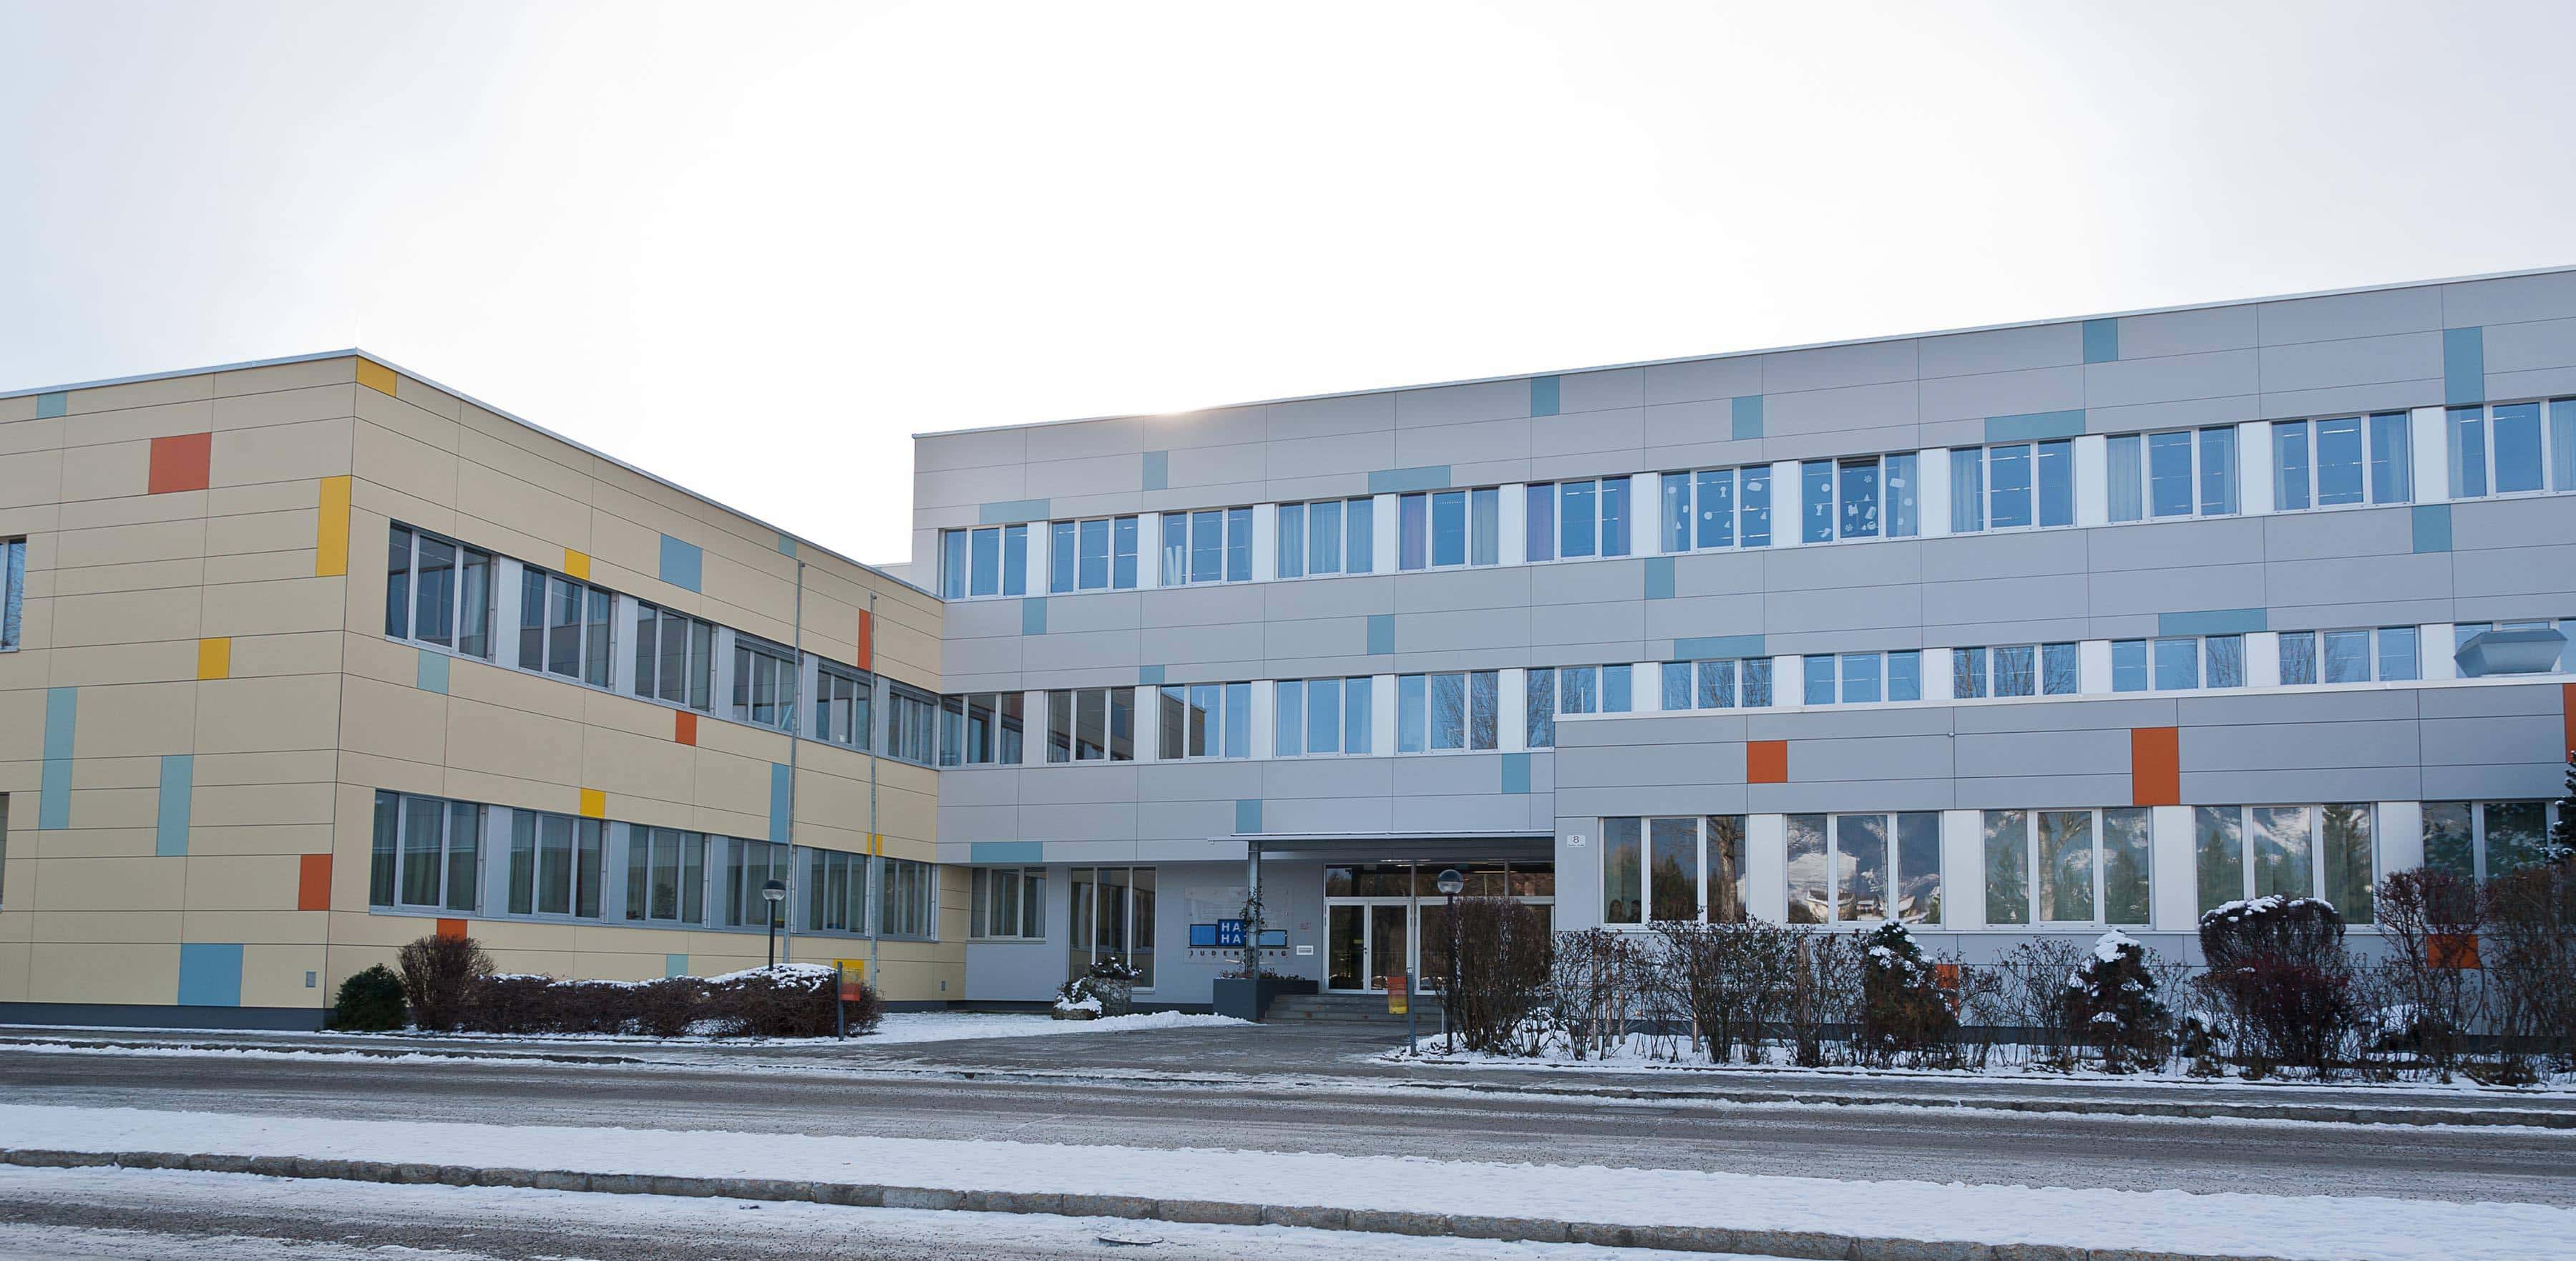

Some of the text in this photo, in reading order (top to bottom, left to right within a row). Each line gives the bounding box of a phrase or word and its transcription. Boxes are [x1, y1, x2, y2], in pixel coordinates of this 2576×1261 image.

[1573, 835, 1579, 844] 8
[1221, 922, 1246, 932] HA
[1221, 934, 1246, 944] HA
